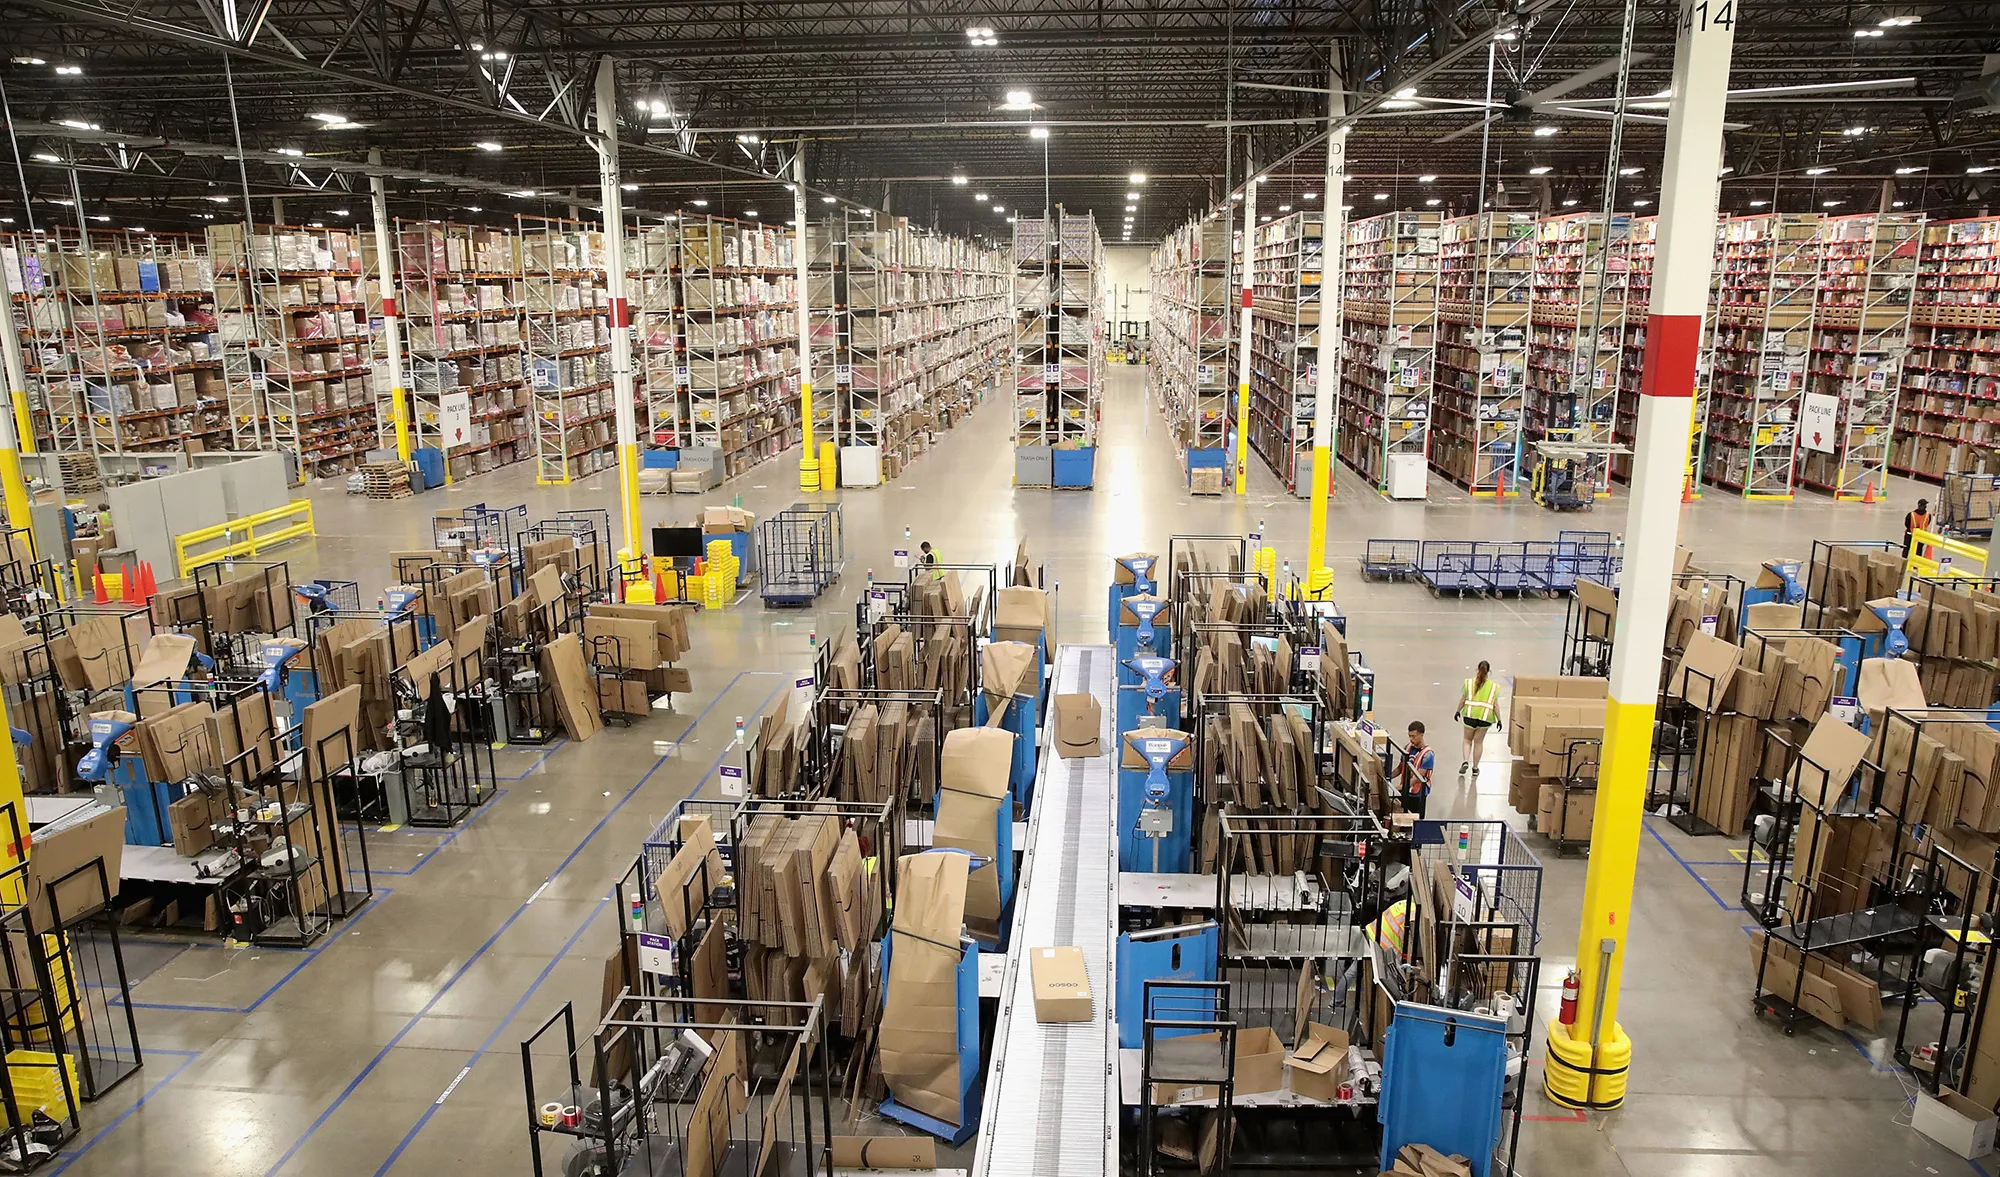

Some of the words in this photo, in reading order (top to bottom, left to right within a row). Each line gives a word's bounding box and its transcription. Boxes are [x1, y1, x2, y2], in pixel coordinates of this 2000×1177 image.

[1696, 0, 1734, 31] 14
[1332, 143, 1342, 155] D
[1329, 165, 1343, 177] 14
[1248, 189, 1254, 197] E
[796, 195, 802, 203] E
[1246, 202, 1255, 210] 14
[1809, 404, 1820, 414] PACK
[1820, 407, 1832, 416] LINE
[1307, 661, 1313, 669] 8
[1840, 710, 1846, 718] 3
[1458, 903, 1466, 918] 10
[646, 940, 664, 948] STATION
[653, 956, 660, 967] 5
